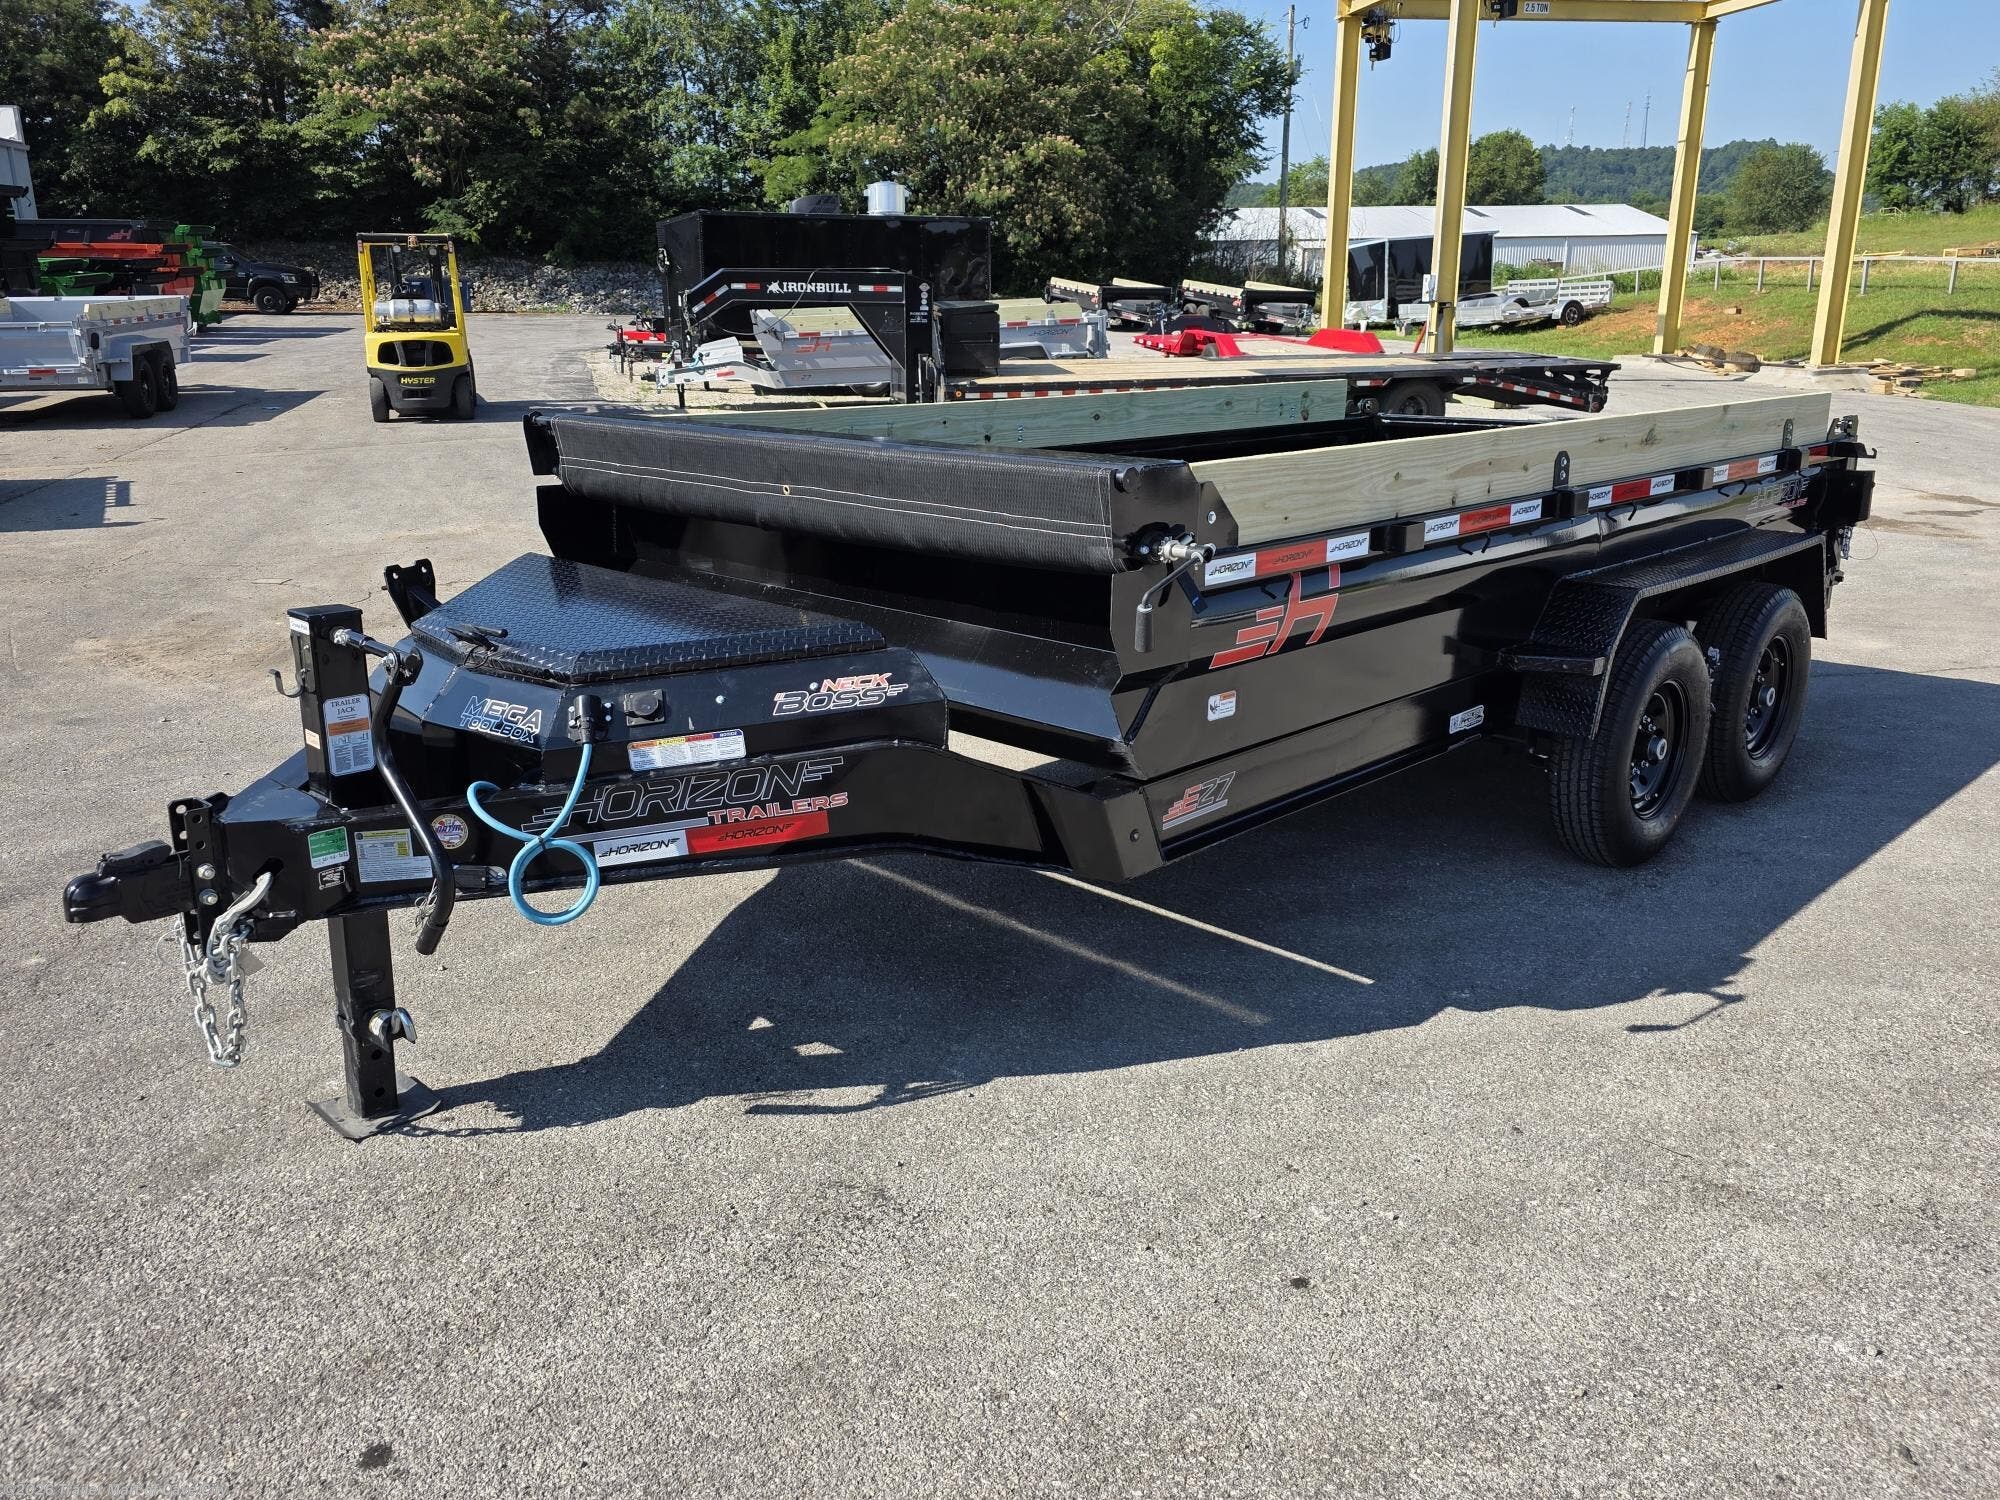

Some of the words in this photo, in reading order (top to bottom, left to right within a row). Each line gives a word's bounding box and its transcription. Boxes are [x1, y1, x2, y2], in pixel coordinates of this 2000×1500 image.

[1525, 3, 1535, 12] 2.5
[1536, 3, 1548, 12] TON
[783, 282, 851, 294] IRONBULL
[1329, 537, 1368, 553] HORIZON
[1209, 559, 1254, 577] HORIZON
[820, 672, 892, 693] NECK
[331, 698, 361, 708] TRAILER
[337, 706, 356, 715] JACK
[773, 685, 898, 716] BOSS
[462, 695, 542, 734] MEGA
[459, 712, 535, 743] TOOLBOX
[535, 757, 836, 831] HORIZON
[707, 791, 849, 825] TRAILERS
[717, 823, 796, 843] HORIZON
[598, 837, 680, 858] HORIZON
